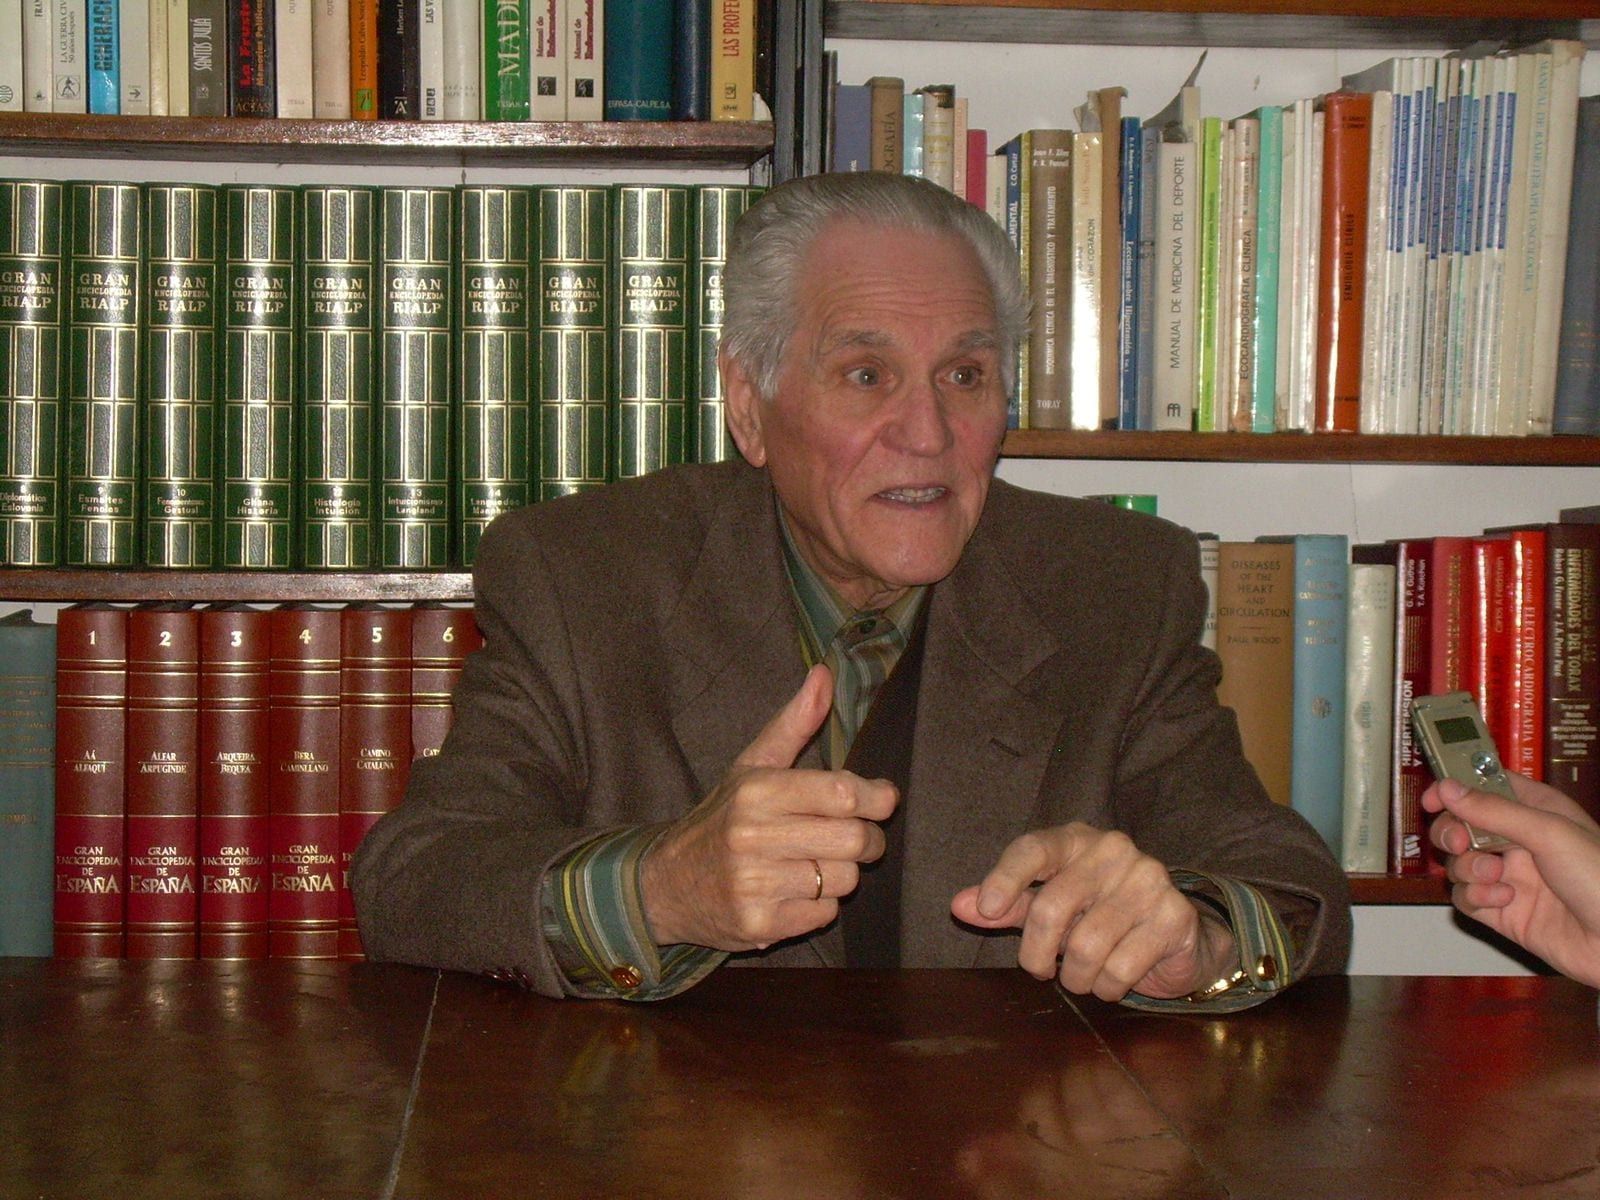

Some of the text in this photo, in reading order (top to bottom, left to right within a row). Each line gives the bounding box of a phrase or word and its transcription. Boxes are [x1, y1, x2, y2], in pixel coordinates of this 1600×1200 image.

[68, 11, 77, 39] después
[722, 0, 740, 57] LAS PROFE
[60, 17, 68, 51] GUERRA
[536, 27, 545, 58] Manual
[574, 30, 582, 60] Manual
[61, 53, 68, 63] LA
[192, 43, 212, 71] SANTOS
[1241, 229, 1252, 273] CLINICA
[1169, 155, 1185, 369] MANUAL DE MEDICINA DEL DEPORTE
[3, 272, 52, 285] GRAN
[80, 274, 130, 287] GRAN
[156, 276, 207, 289] GRAN
[234, 277, 284, 290] GRAN
[313, 277, 364, 290] GRAN
[392, 277, 442, 290] GRAN
[470, 277, 520, 290] GRAN
[548, 277, 598, 289] GRAN
[628, 275, 679, 288] GRAN
[77, 286, 133, 296] ENCICLOPEDIA
[154, 289, 210, 299] ENCICLOPEDIA
[231, 289, 289, 299] ENCICLOPEDIA
[310, 290, 367, 300] ENCICLOPEDIA
[389, 290, 445, 300] ENCICLOPEDIA
[467, 290, 524, 299] ENCICLOPEDIA
[545, 290, 601, 299] ENCICLOPEDIA
[625, 289, 682, 298] ENCICLOPEDIA
[1124, 240, 1135, 355] Lecciones sobre Hipertensión
[2, 296, 52, 309] RIALP
[80, 297, 129, 311] RIALP
[157, 300, 207, 312] RIALP
[234, 301, 284, 313] RIALP
[314, 301, 364, 314] RIALP
[392, 301, 442, 314] RIALP
[471, 301, 520, 314] RIALP
[549, 301, 598, 313] RIALP
[629, 300, 679, 312] RIALP
[1239, 276, 1251, 380] ECOCARDIOGRAFIA
[177, 488, 187, 497] 10
[1231, 560, 1281, 570] DISEASES
[1553, 548, 1565, 574] Robert
[1256, 573, 1272, 582] THE
[1406, 559, 1415, 588] Guthrie
[1238, 584, 1274, 594] HEART
[1219, 607, 1290, 617] CIRCULATION
[1494, 606, 1504, 633] Carlos
[1567, 548, 1582, 692] ENFERMEDADES DEL TORAX
[88, 631, 96, 646] 1
[158, 631, 172, 648] 2
[230, 631, 243, 648] 3
[298, 628, 312, 645] 4
[371, 627, 383, 644] 5
[442, 626, 454, 643] 6
[1522, 606, 1536, 742] ELECTROCARDIOGRAFIA
[150, 751, 177, 762] ALFAR
[1522, 747, 1534, 762] DE
[74, 846, 103, 856] GRAN
[148, 846, 177, 856] GRAN
[219, 846, 250, 856] GRAN
[288, 844, 319, 854] GRAN
[56, 856, 121, 865] ENCICLOPEDIA
[130, 856, 195, 866] ENCICLOPEDIA
[202, 856, 264, 866] ENCICLOPEDIA
[271, 854, 336, 864] ENCICLOPEDIA
[81, 867, 94, 876] DE
[156, 867, 169, 876] DE
[228, 867, 241, 876] DE
[296, 865, 310, 874] DE
[56, 873, 121, 894] ESPAÑA
[129, 873, 194, 894] ESPAÑA
[271, 871, 336, 892] ESPAÑA
